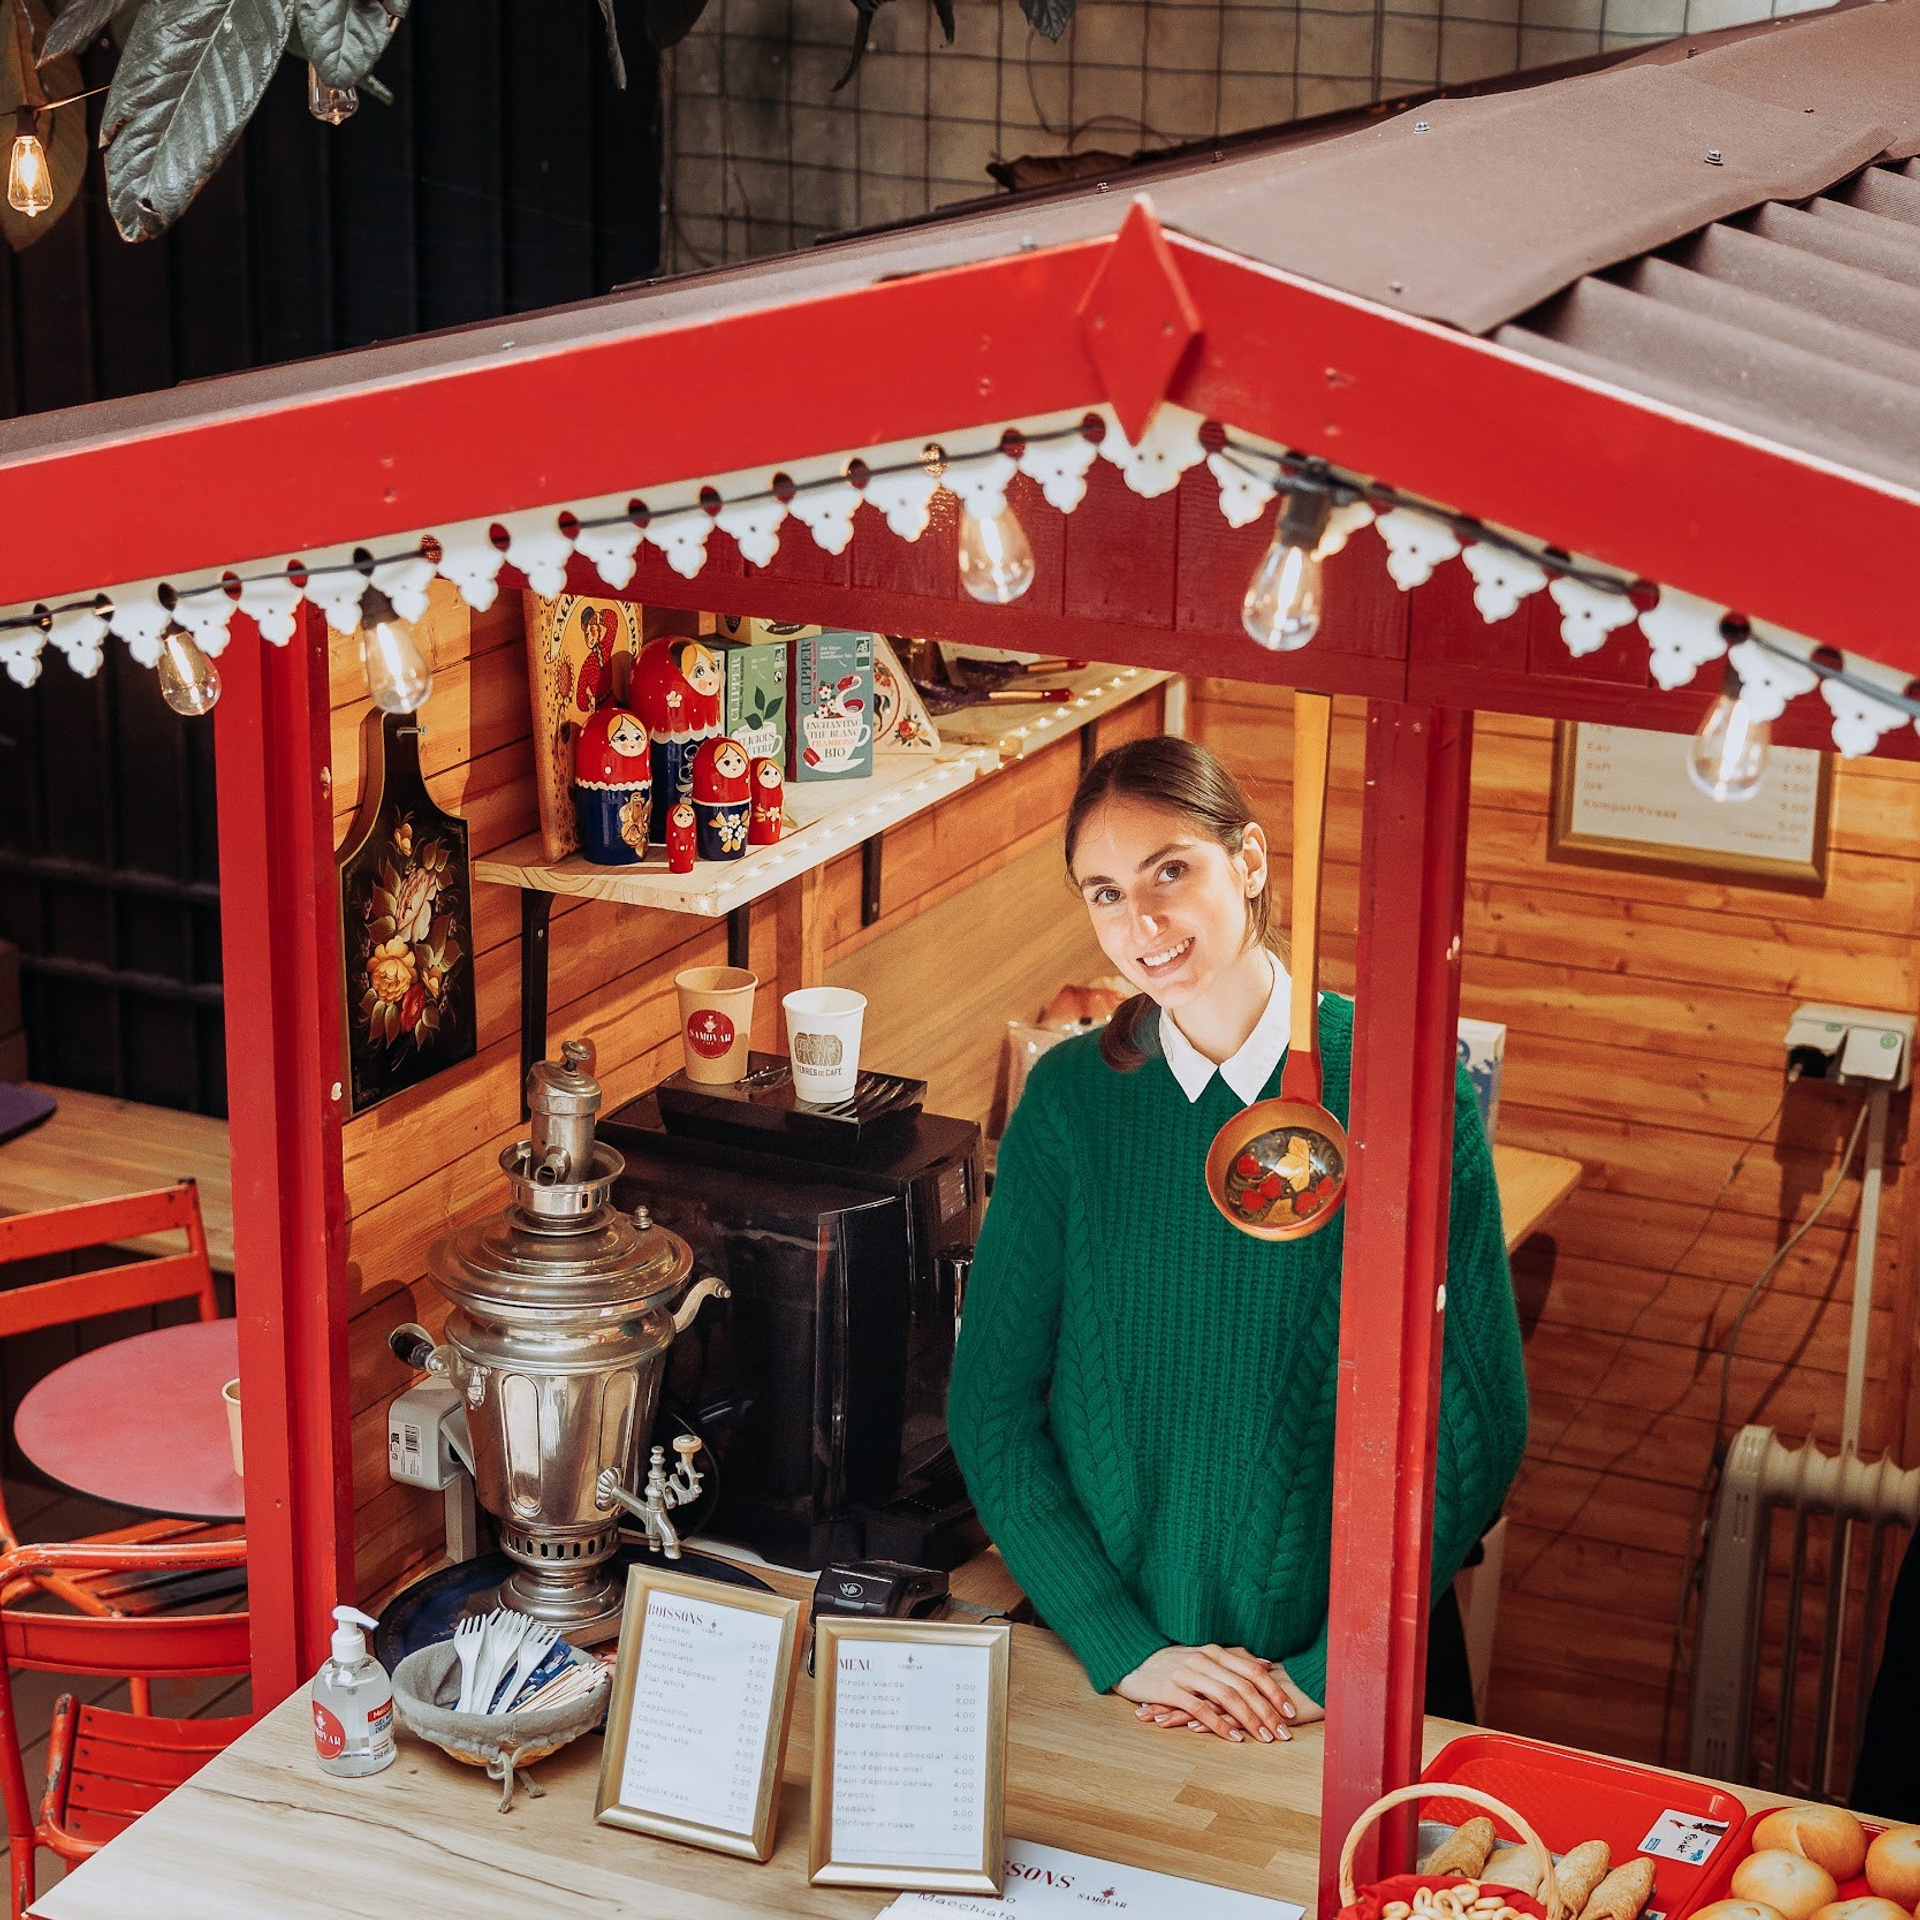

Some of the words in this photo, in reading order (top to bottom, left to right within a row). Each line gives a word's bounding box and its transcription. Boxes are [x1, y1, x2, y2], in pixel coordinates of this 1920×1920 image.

[824, 747, 846, 758] BIO
[689, 1029, 731, 1043] SAMOVAR
[647, 1603, 703, 1626] BOISSONS
[645, 1659, 674, 1671] Double
[839, 1657, 873, 1672] MENU
[873, 1693, 901, 1702] choux
[837, 1748, 857, 1756] Pain
[837, 1762, 857, 1770] Pain
[836, 1805, 876, 1813] Medovik
[917, 1892, 1016, 1920] Macchiato
[1077, 1893, 1128, 1908] SAMOVAR
